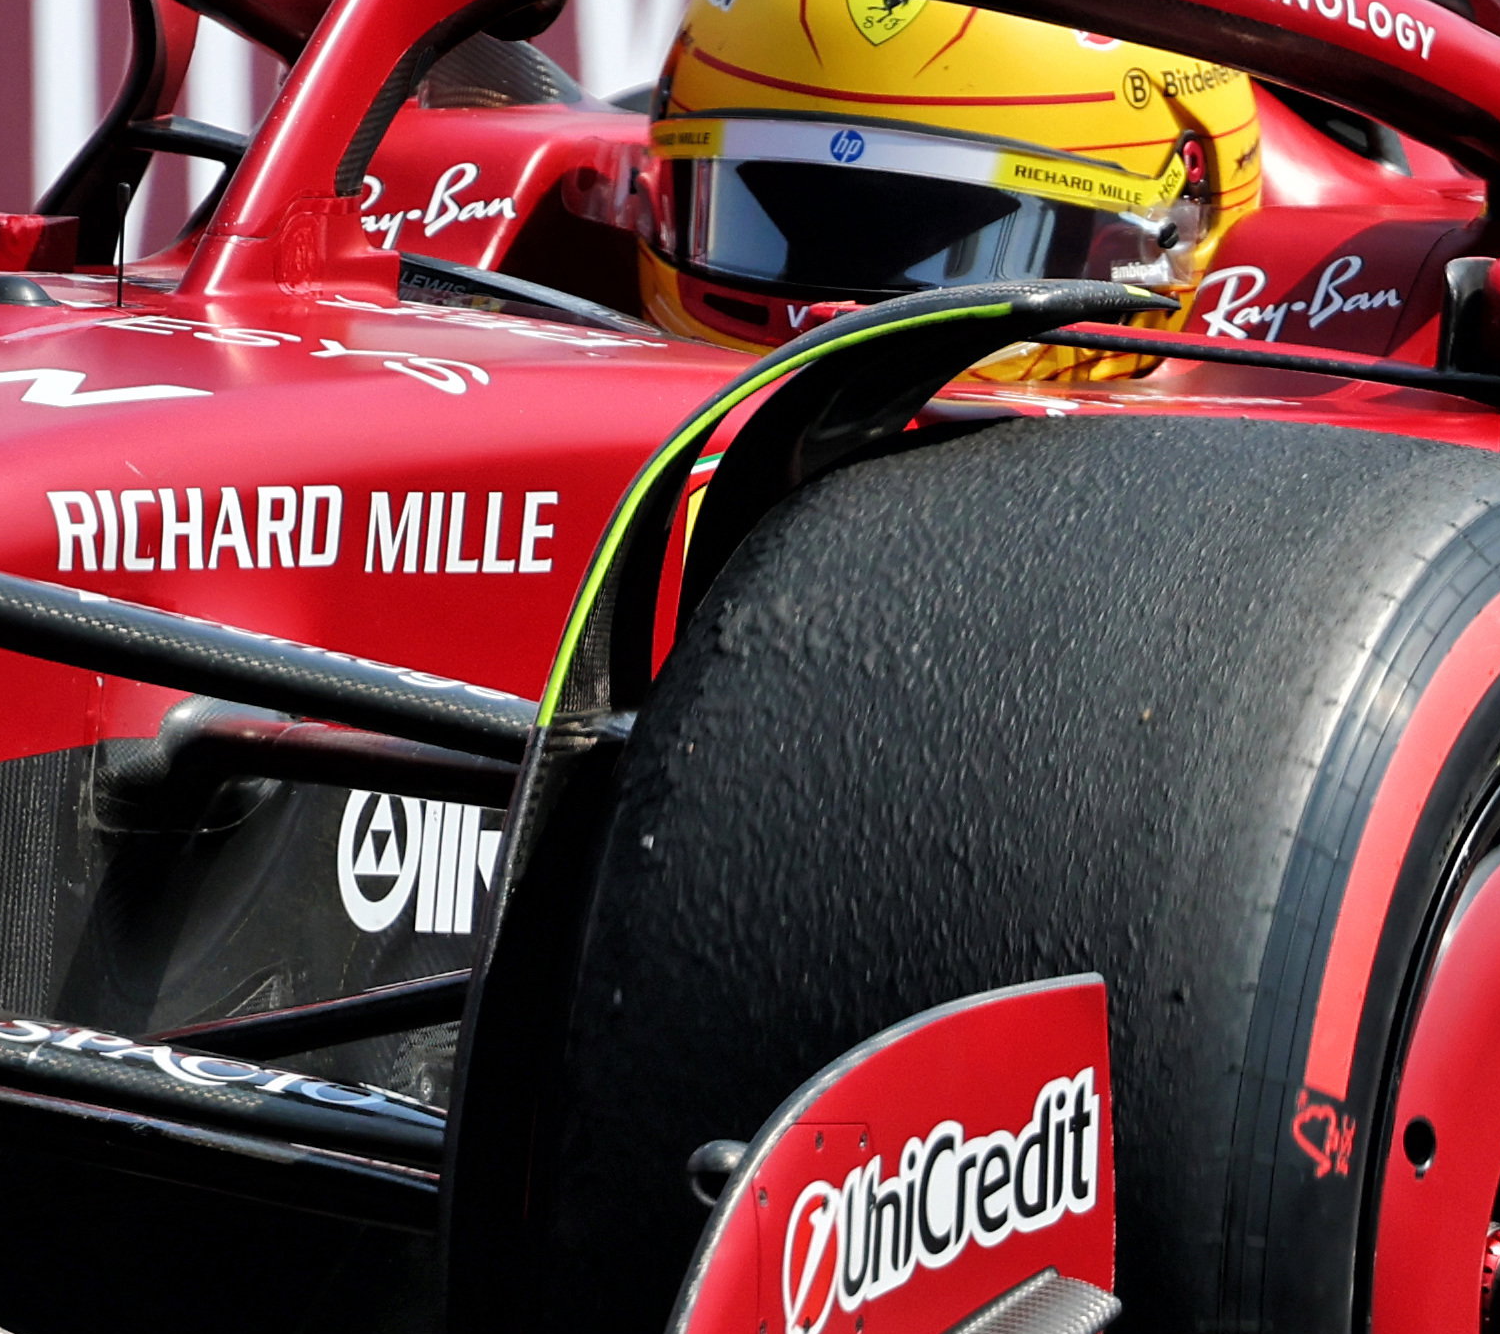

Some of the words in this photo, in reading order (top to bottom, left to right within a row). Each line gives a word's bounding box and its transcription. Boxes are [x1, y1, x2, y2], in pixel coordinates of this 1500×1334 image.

[1014, 164, 1094, 192] RICHARD
[1099, 183, 1143, 205] MILLE
[1200, 255, 1401, 342] Ray-Ban
[46, 484, 343, 572] RICHARD
[364, 490, 559, 574] MILLE
[838, 1071, 1099, 1307] UniCredit
